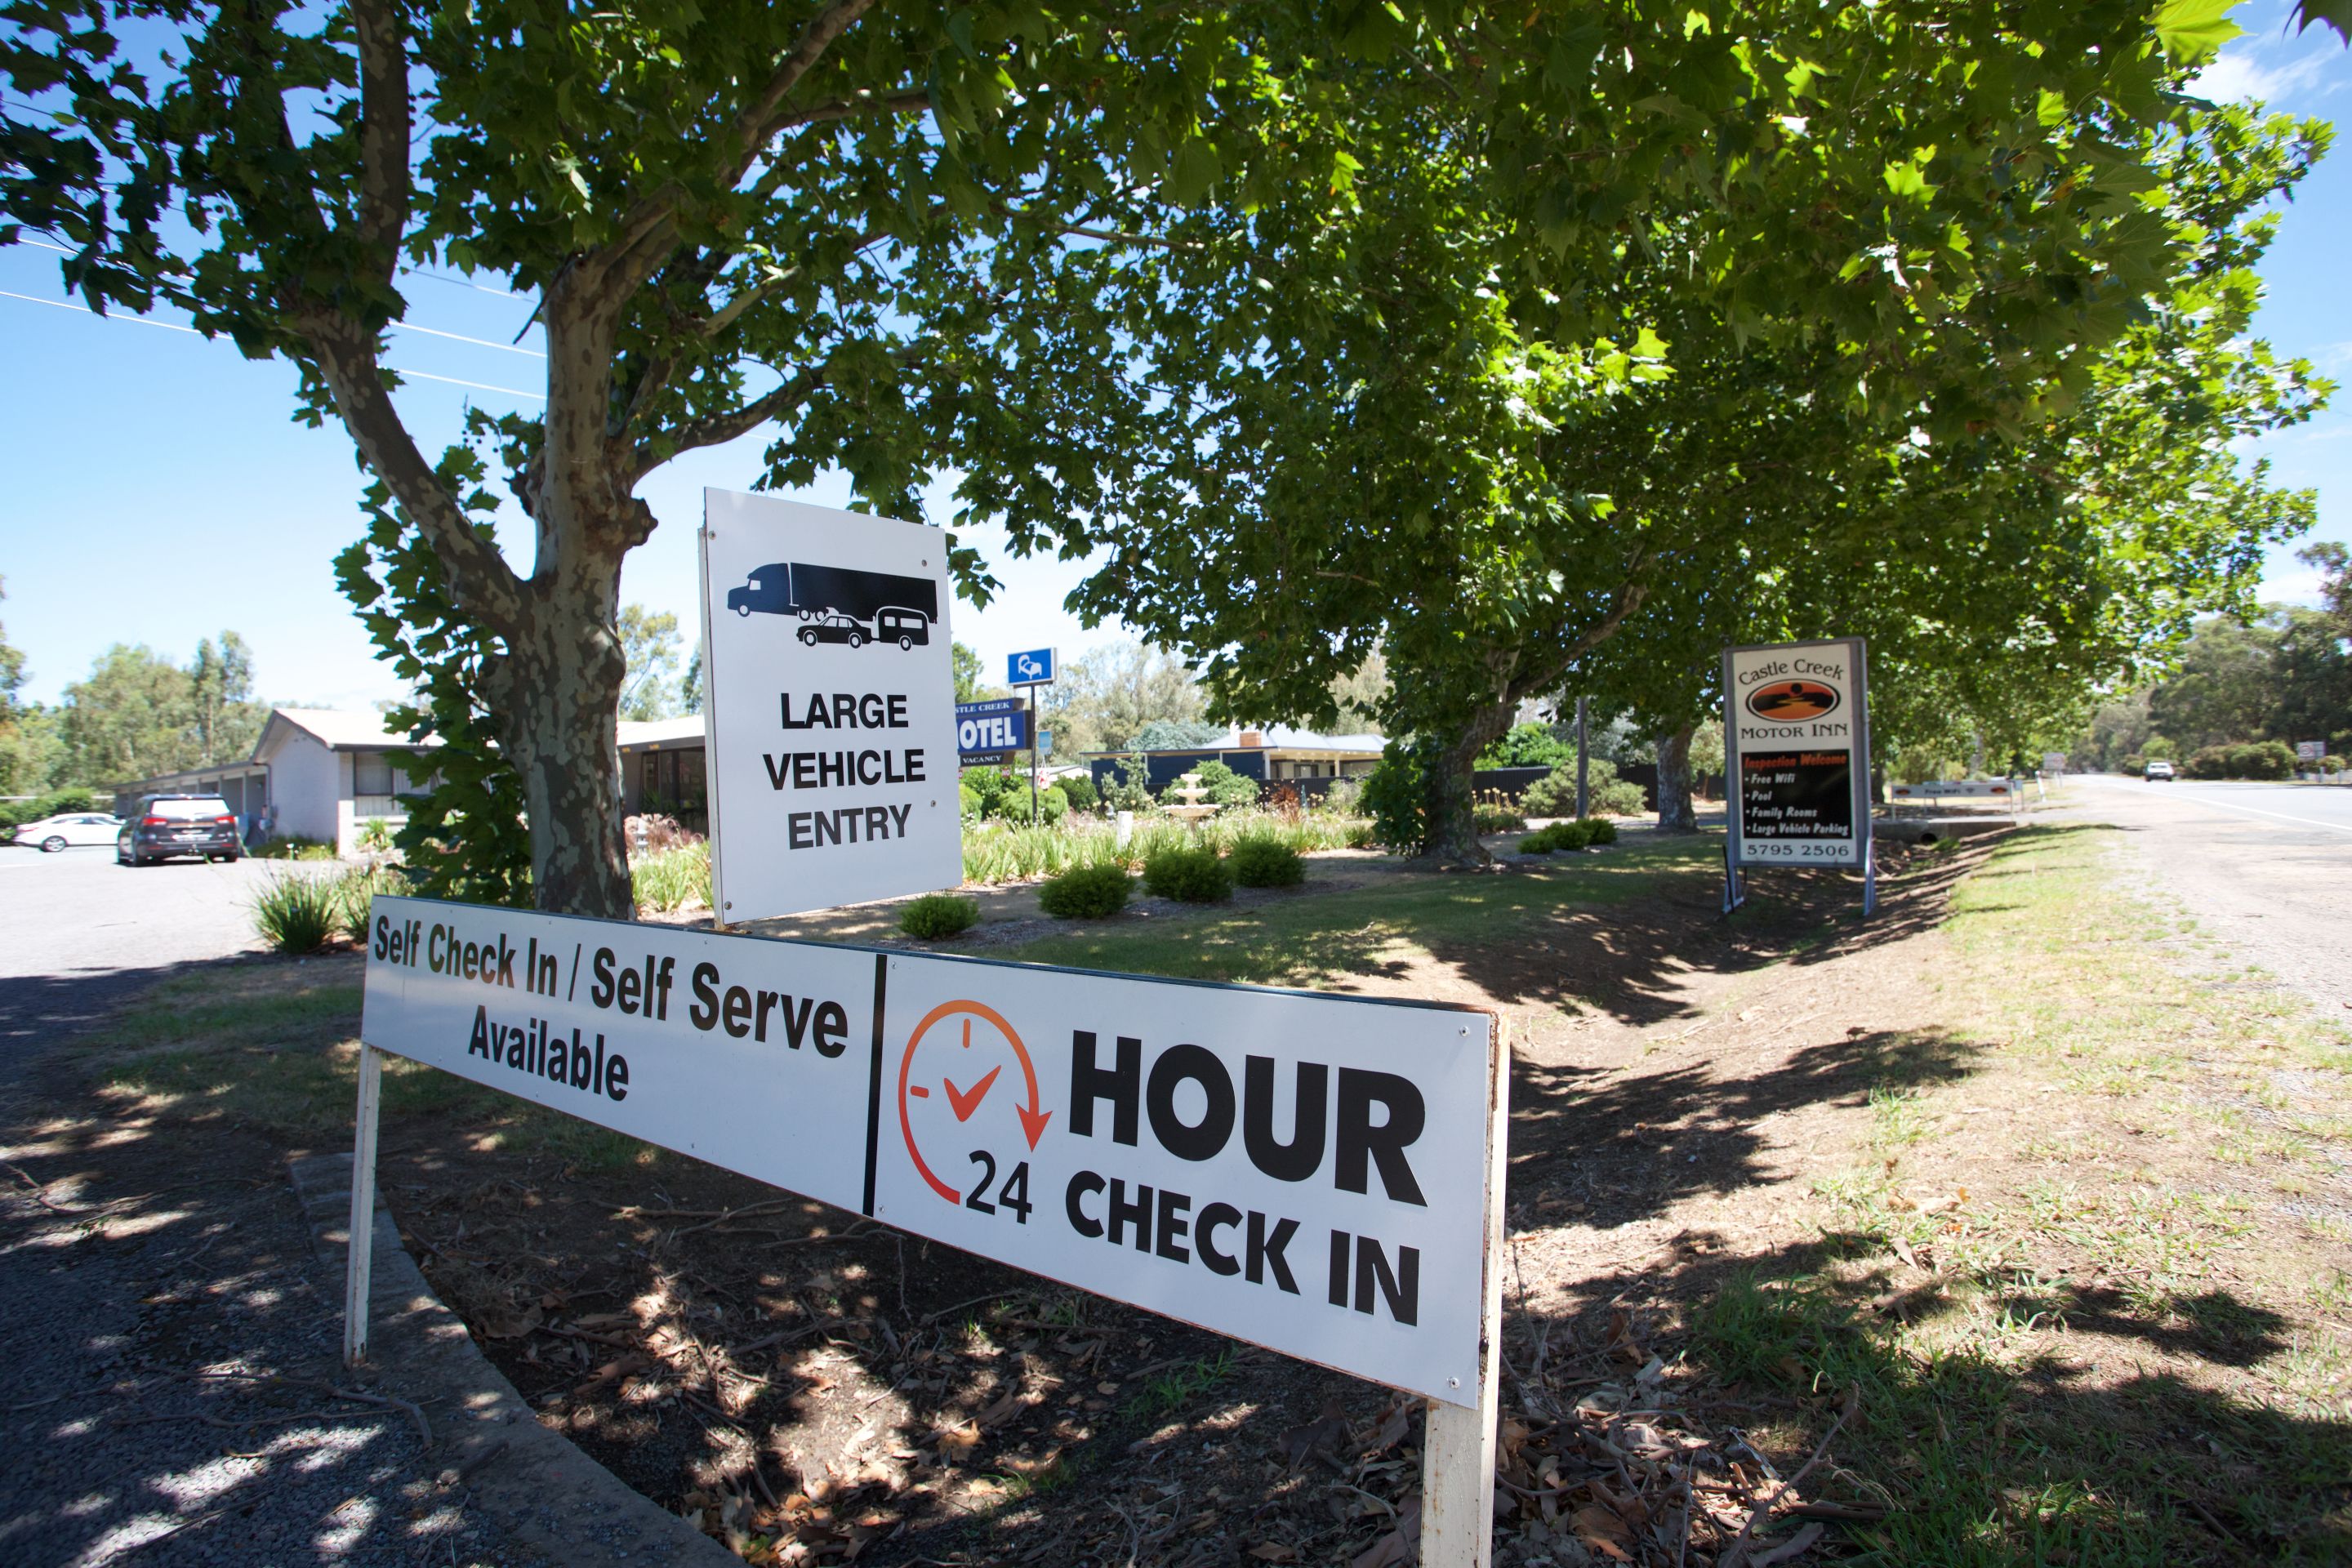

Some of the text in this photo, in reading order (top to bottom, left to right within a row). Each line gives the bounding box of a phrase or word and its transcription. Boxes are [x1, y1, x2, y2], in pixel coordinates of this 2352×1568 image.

[1739, 659, 1844, 685] Castle Creek
[781, 693, 909, 729] LARGE
[955, 702, 1010, 713] STLE CREEK
[960, 717, 1017, 750] OTEL
[1741, 724, 1848, 739] MOTOR INN
[763, 749, 926, 791] VEHICLE
[963, 755, 1002, 764] VACANCY
[1744, 754, 1847, 771] Inspection Welcome
[1751, 773, 1795, 784] Free Wifi
[1751, 791, 1772, 800] Pool
[1752, 806, 1818, 819] Family Rooms
[788, 804, 912, 850] ENTRY
[1752, 823, 1848, 836] Large Vehicle Parking
[1747, 844, 1849, 856] 5795 2506
[375, 915, 849, 1058] Self Check In / Self Serve
[468, 1004, 630, 1102] Available
[1069, 1030, 1428, 1207] HOUR
[966, 1150, 1032, 1225] 24
[1065, 1170, 1420, 1327] CHECK IN
